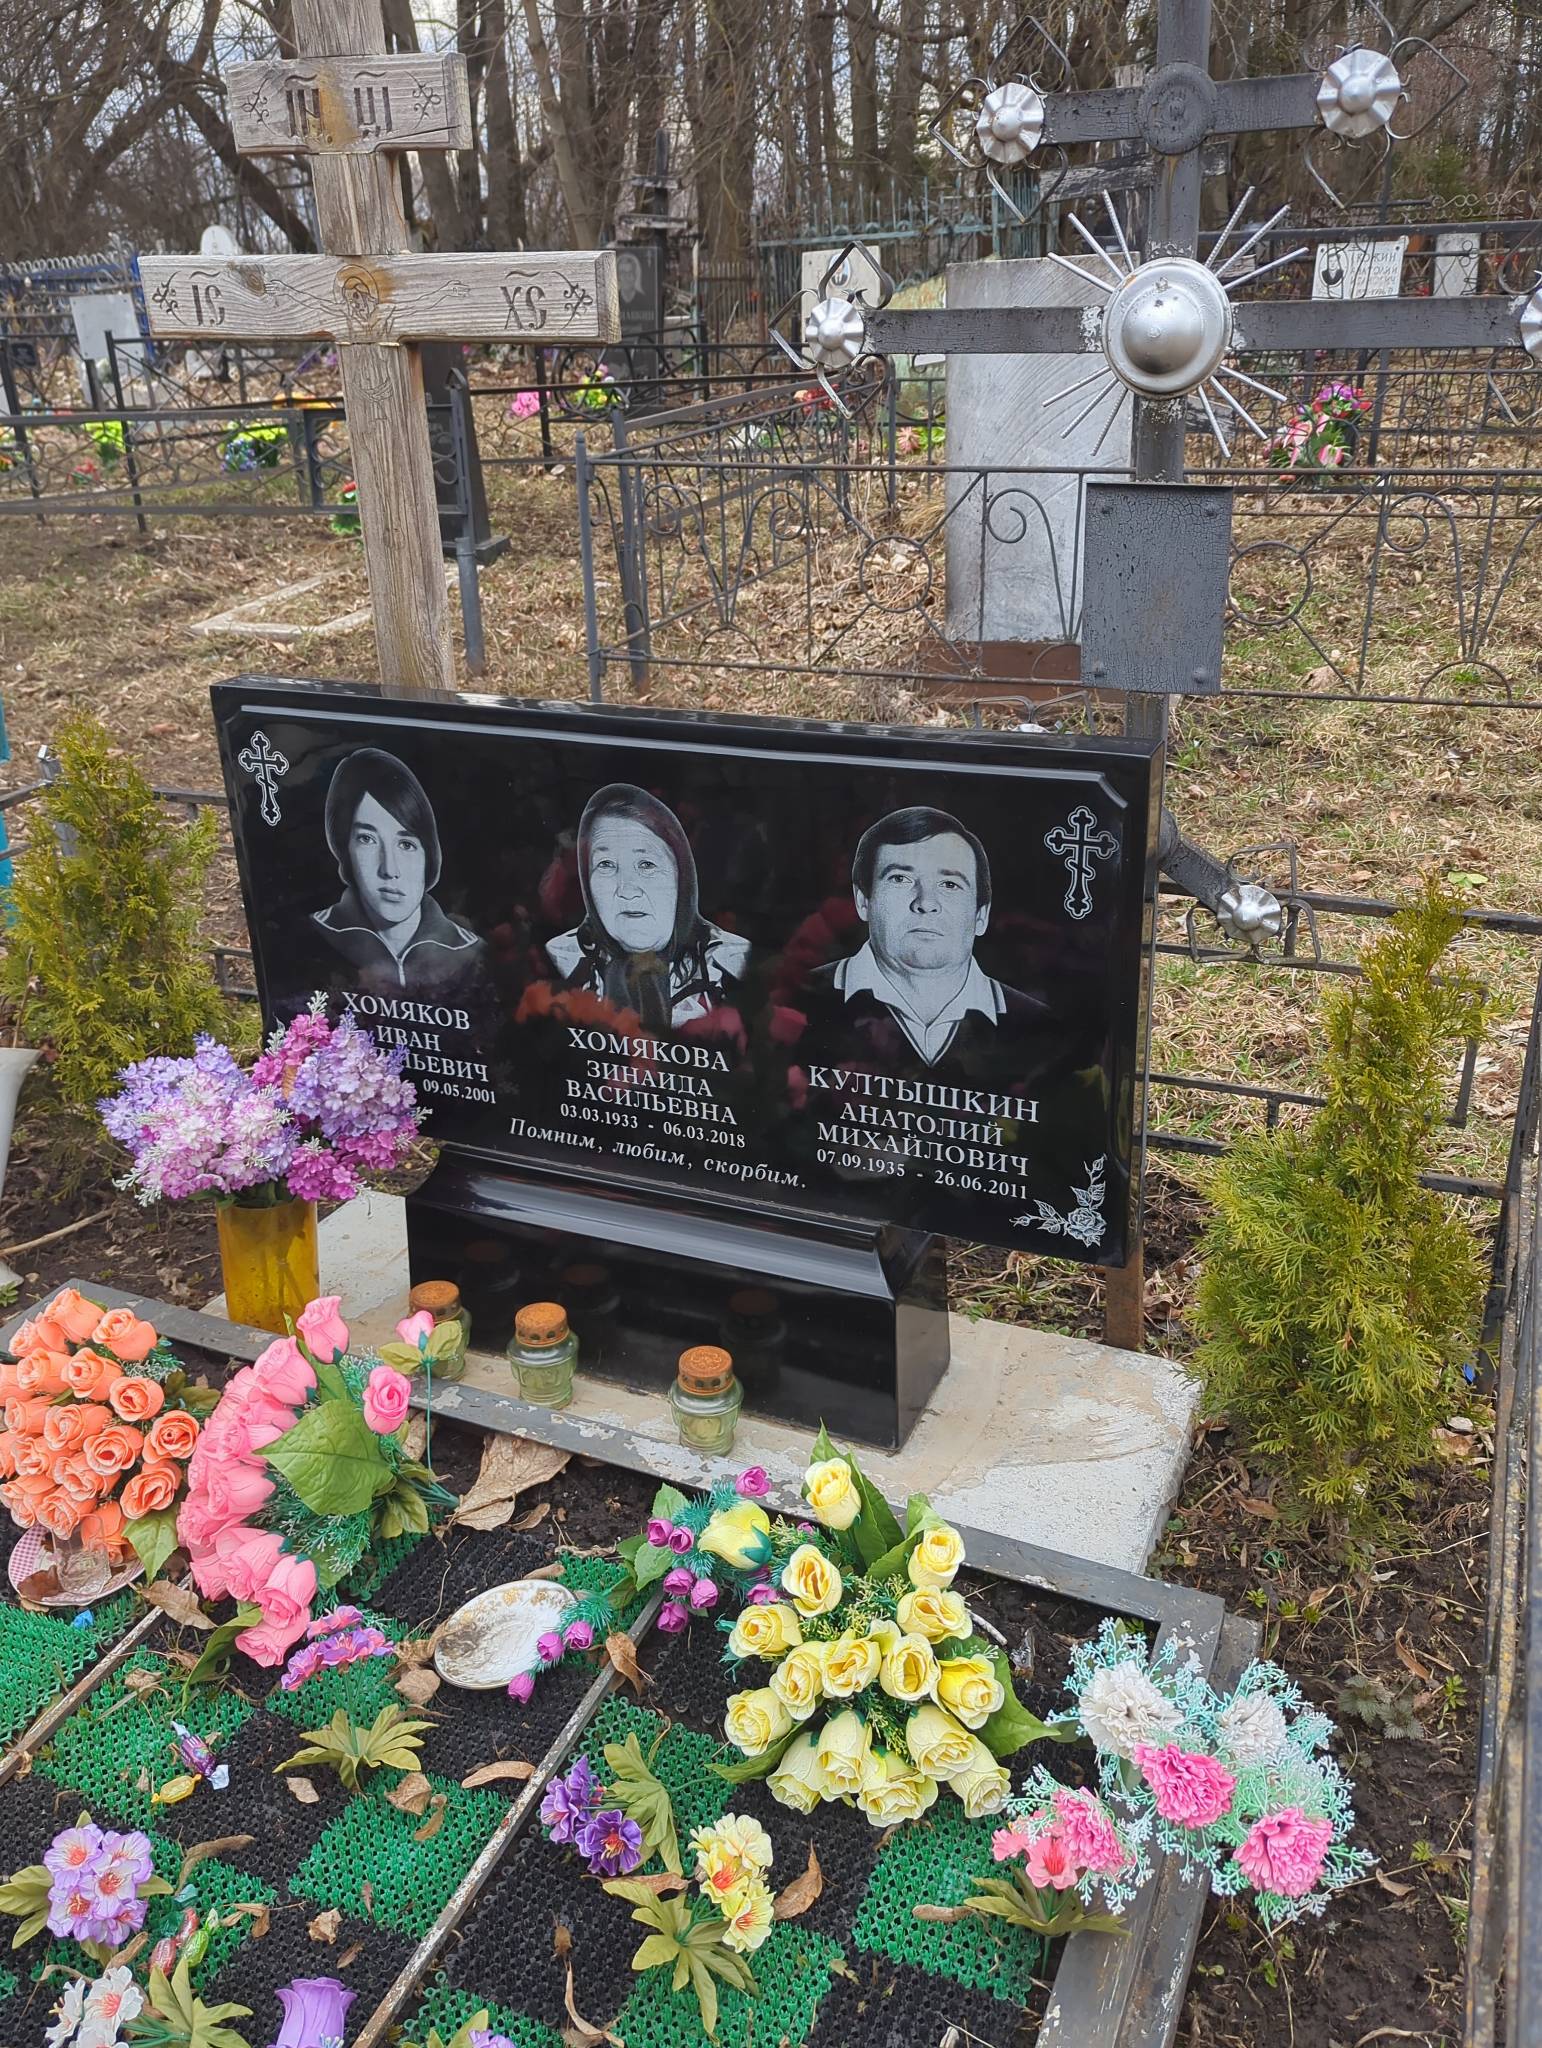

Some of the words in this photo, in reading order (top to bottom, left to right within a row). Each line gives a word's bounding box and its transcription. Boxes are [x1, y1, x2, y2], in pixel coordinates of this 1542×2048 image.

[341, 991, 470, 1030] ХОМЯКОВ
[376, 1025, 441, 1052] ИВАН
[567, 1027, 731, 1072] ХОМЯКОВА
[423, 1079, 497, 1104] 09.05.2001
[587, 1060, 714, 1098] ЗИНАИДА
[808, 1065, 1040, 1123] КУЛТЫШКИН
[566, 1079, 738, 1125] ВАСИЛЬЕВНА
[840, 1102, 1005, 1147] АНАТОЛИЙ
[560, 1103, 638, 1129] 03.03.1933
[663, 1121, 746, 1149] 06.03.2018
[509, 1118, 604, 1153] Помним,
[612, 1141, 693, 1169] любим,
[703, 1158, 807, 1189] скорбим.
[817, 1121, 1030, 1177] МИХАЙЛОВИЧ
[816, 1148, 906, 1177] 07.09.1935
[934, 1169, 1028, 1200] 26.06.2011
